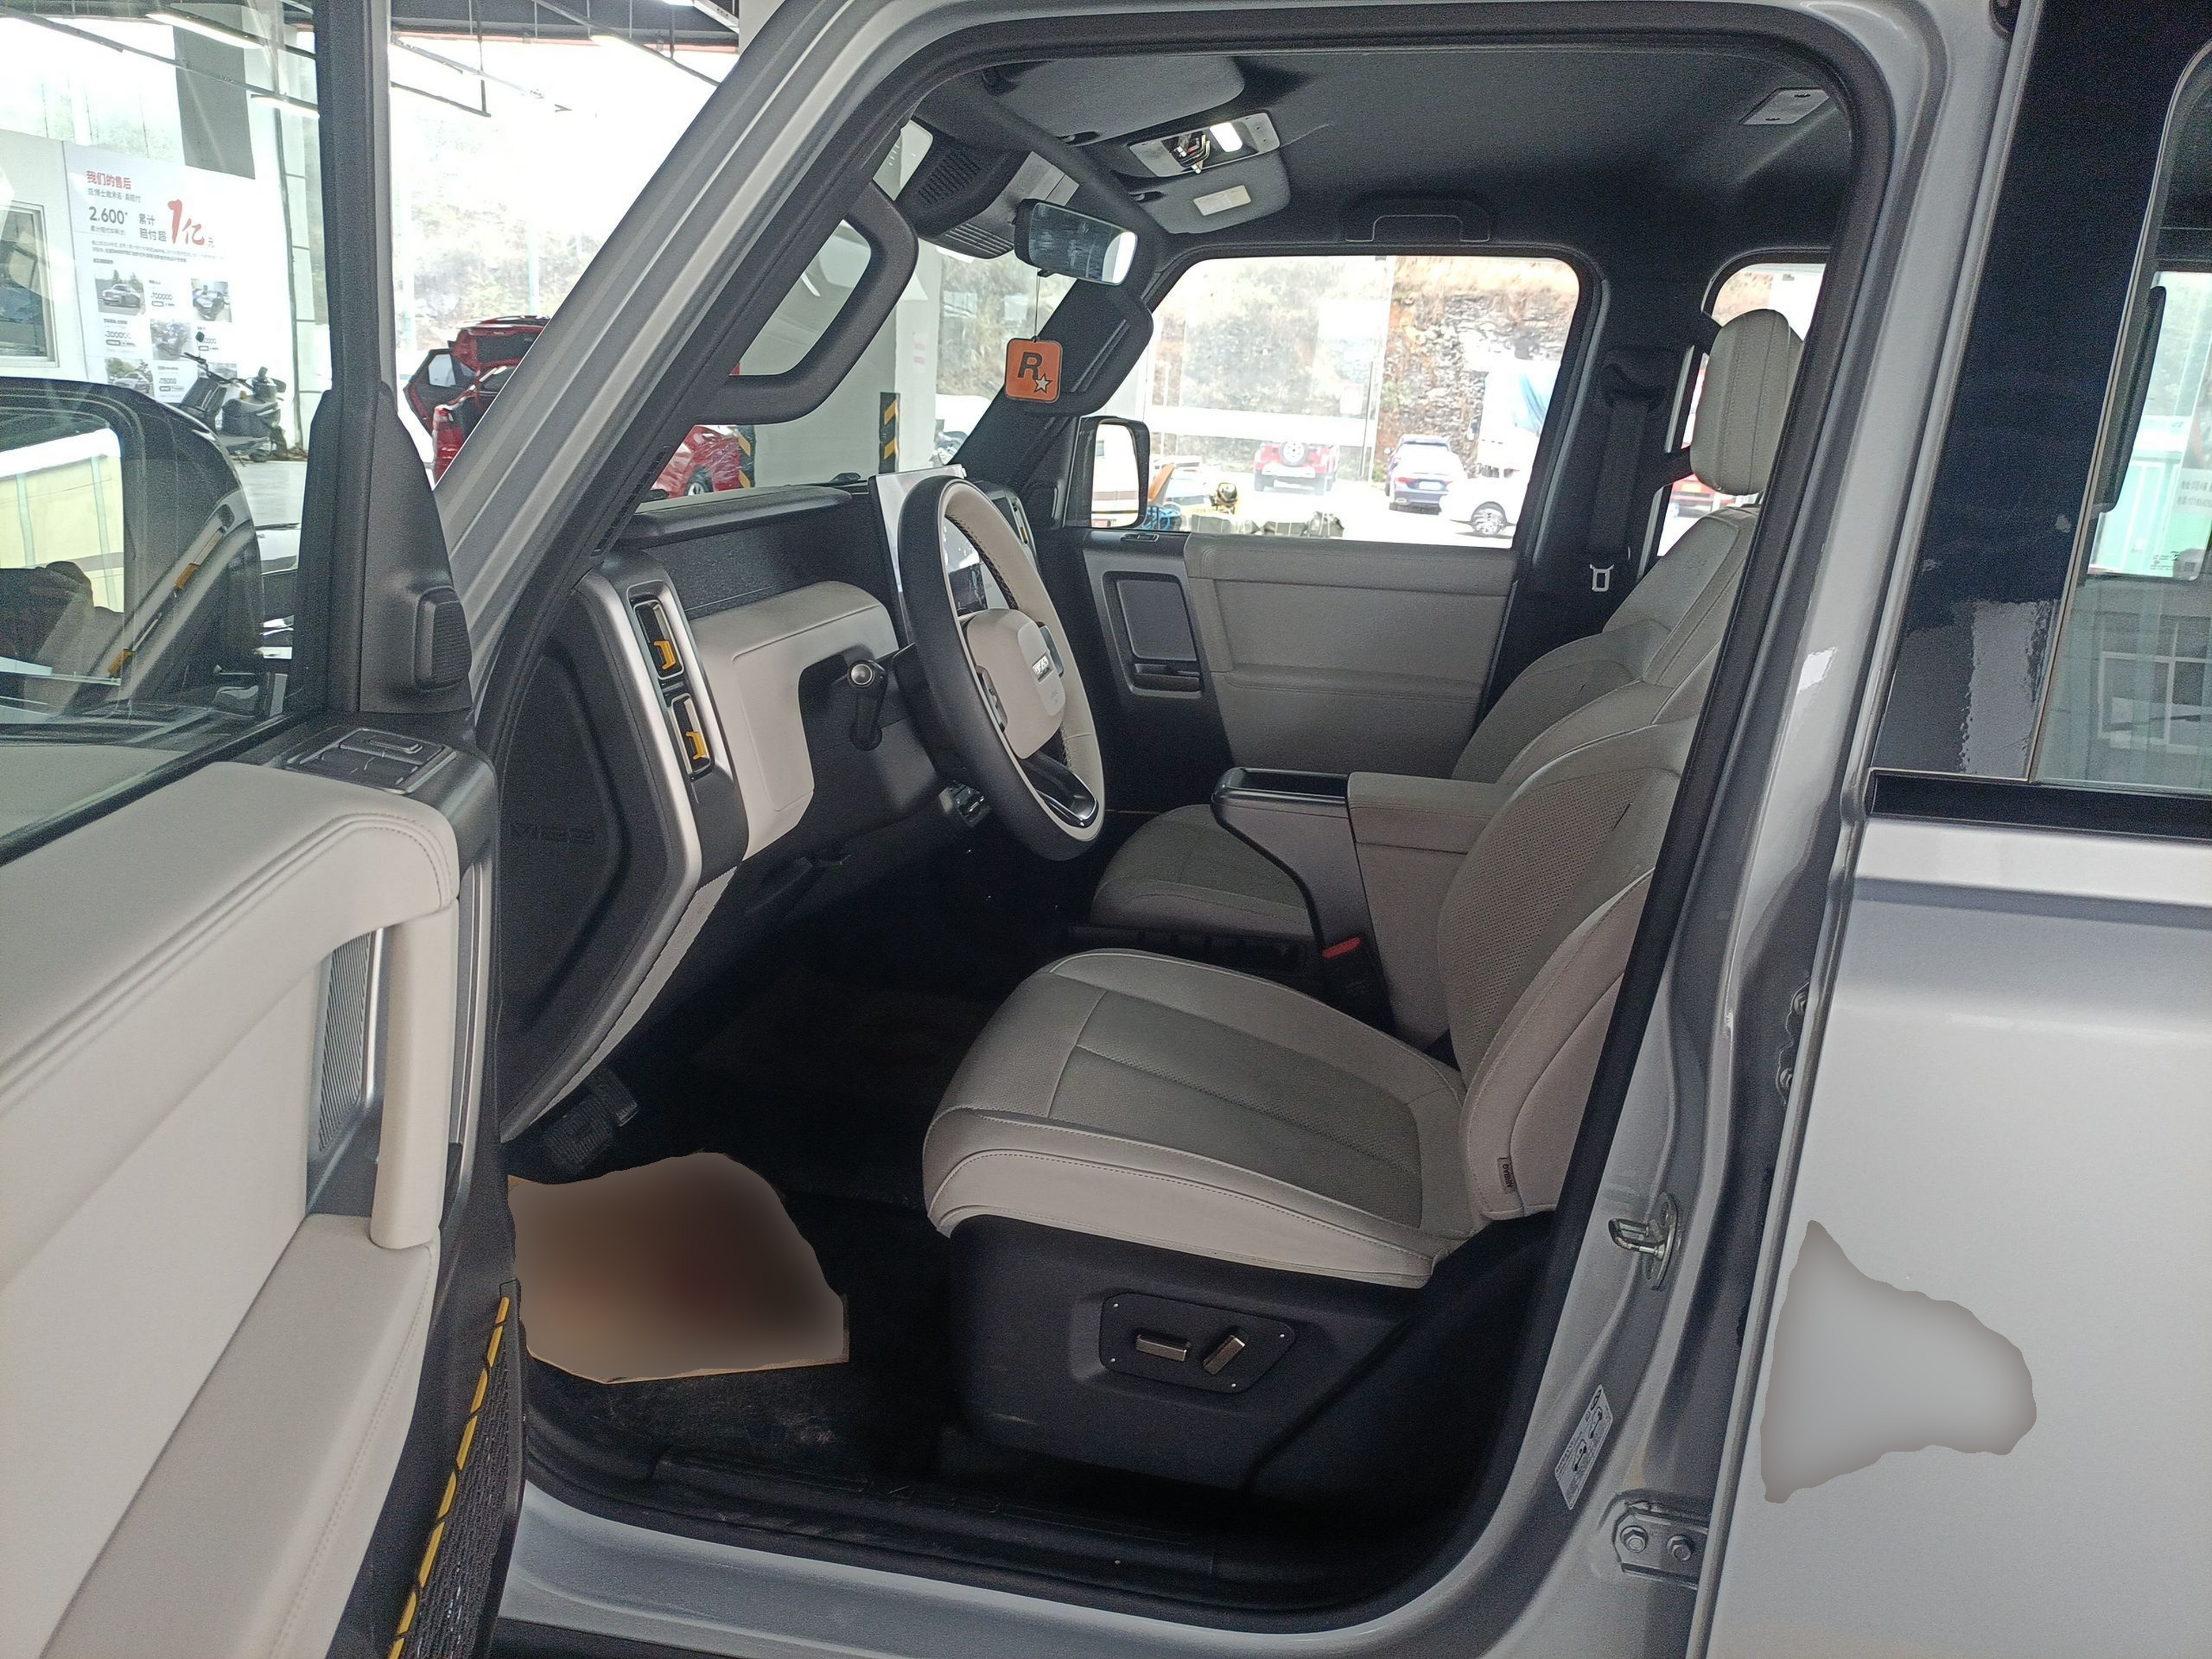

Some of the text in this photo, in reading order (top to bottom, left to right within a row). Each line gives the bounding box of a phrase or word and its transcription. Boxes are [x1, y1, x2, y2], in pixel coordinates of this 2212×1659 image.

[86, 171, 132, 190] 我们的售后
